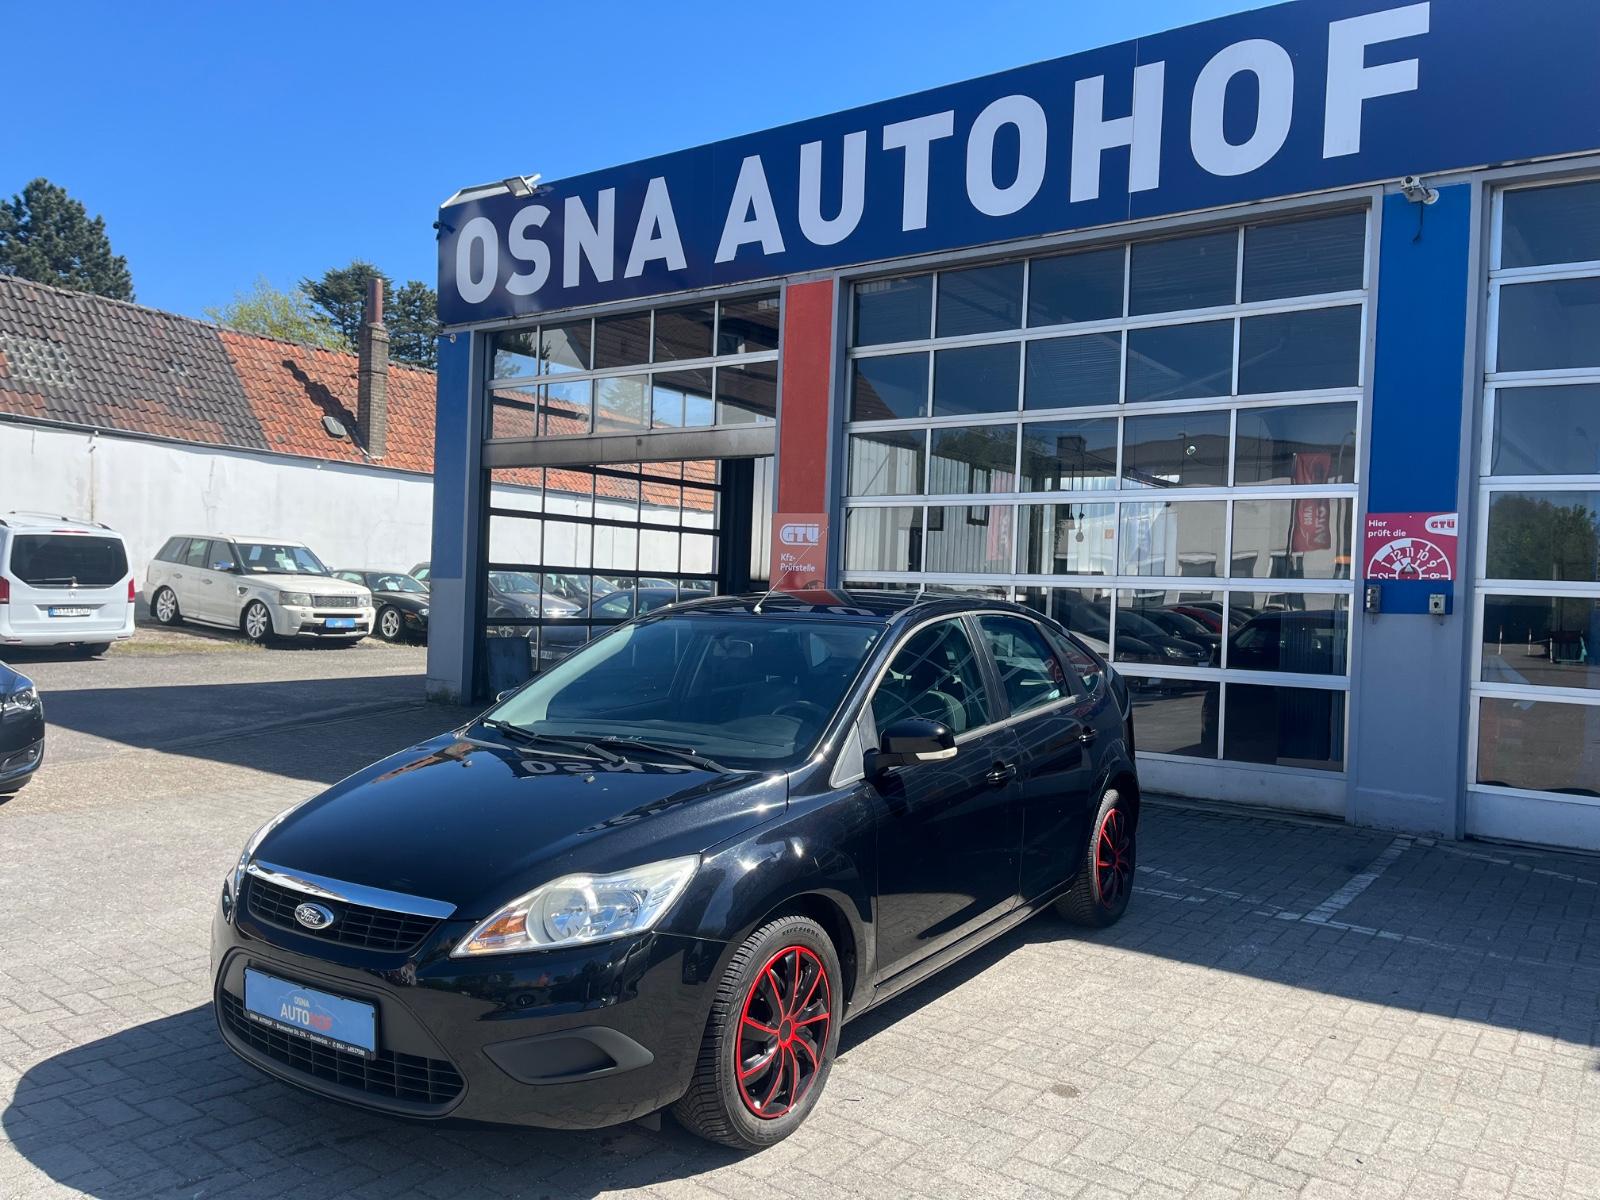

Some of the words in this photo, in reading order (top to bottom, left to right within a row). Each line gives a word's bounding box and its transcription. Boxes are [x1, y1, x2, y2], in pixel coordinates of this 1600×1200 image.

[456, 176, 687, 304] OSNA
[714, 1, 1430, 264] AUTOHOF
[1368, 519, 1387, 527] Hier
[1368, 529, 1391, 538] prüft
[1393, 529, 1407, 537] die
[1390, 550, 1404, 561] 12
[1406, 547, 1414, 557] 11
[1417, 549, 1429, 560] 10
[780, 553, 796, 562] Kfz-
